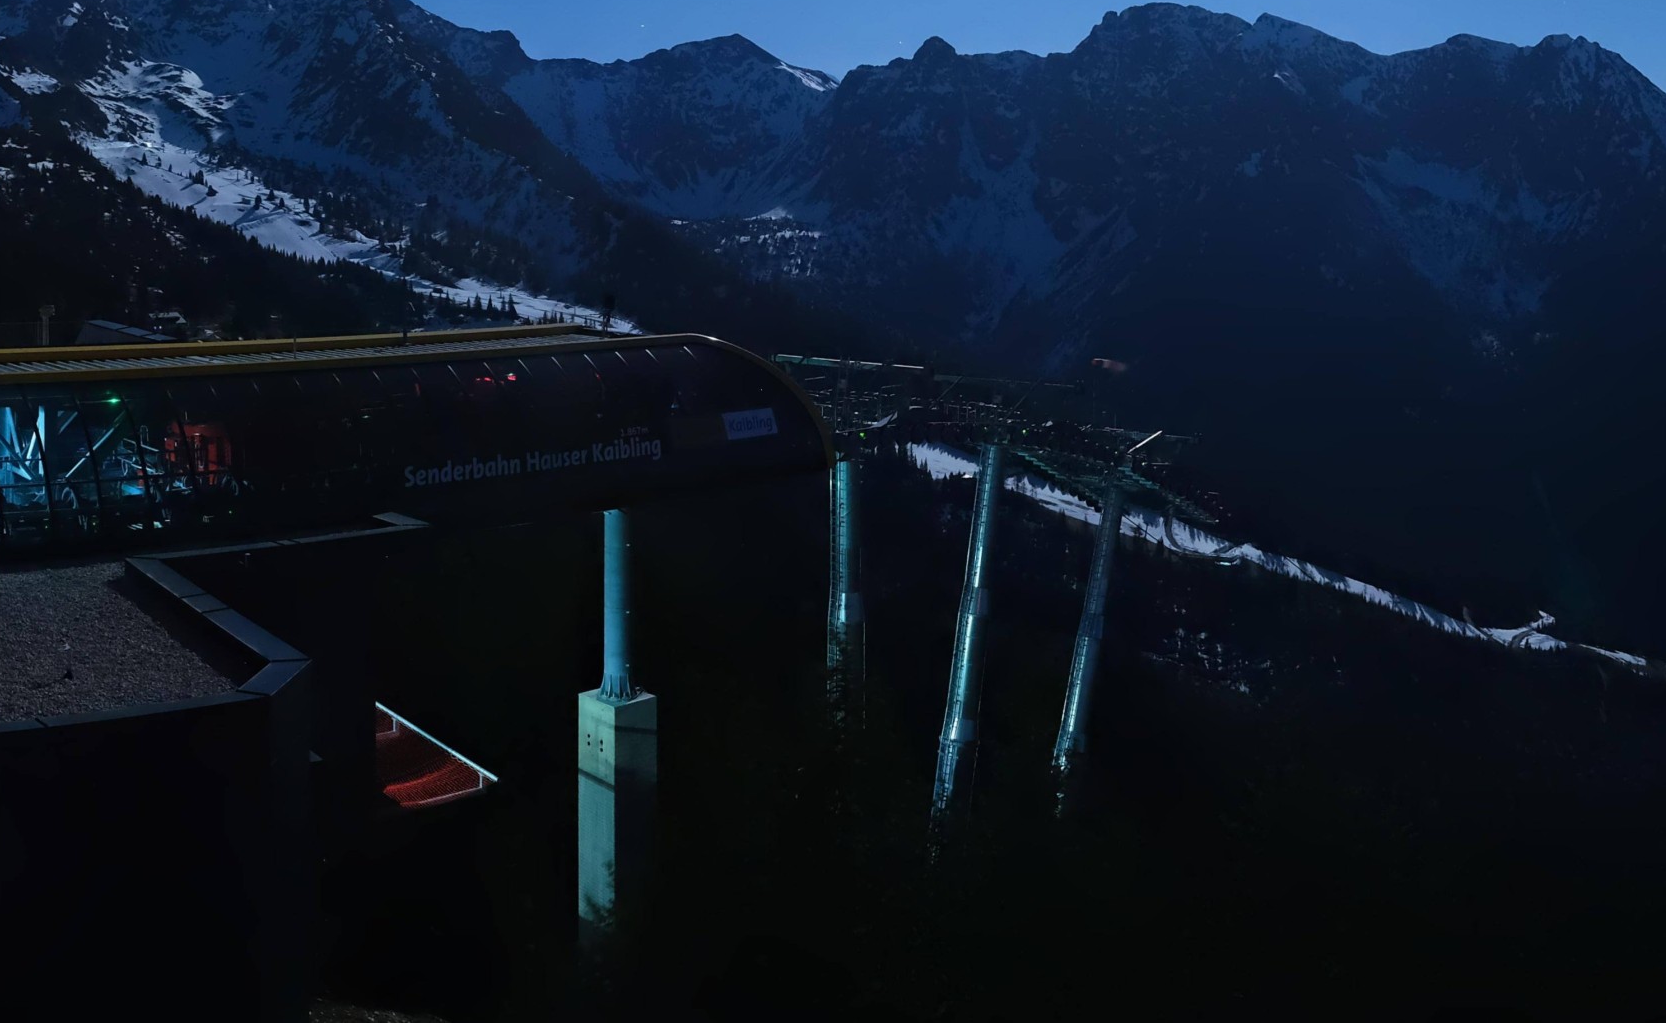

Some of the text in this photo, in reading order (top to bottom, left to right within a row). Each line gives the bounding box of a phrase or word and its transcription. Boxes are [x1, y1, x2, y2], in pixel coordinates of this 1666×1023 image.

[728, 416, 773, 433] Kaibling
[404, 437, 662, 487] Senderbahn Hauser Kaibling
